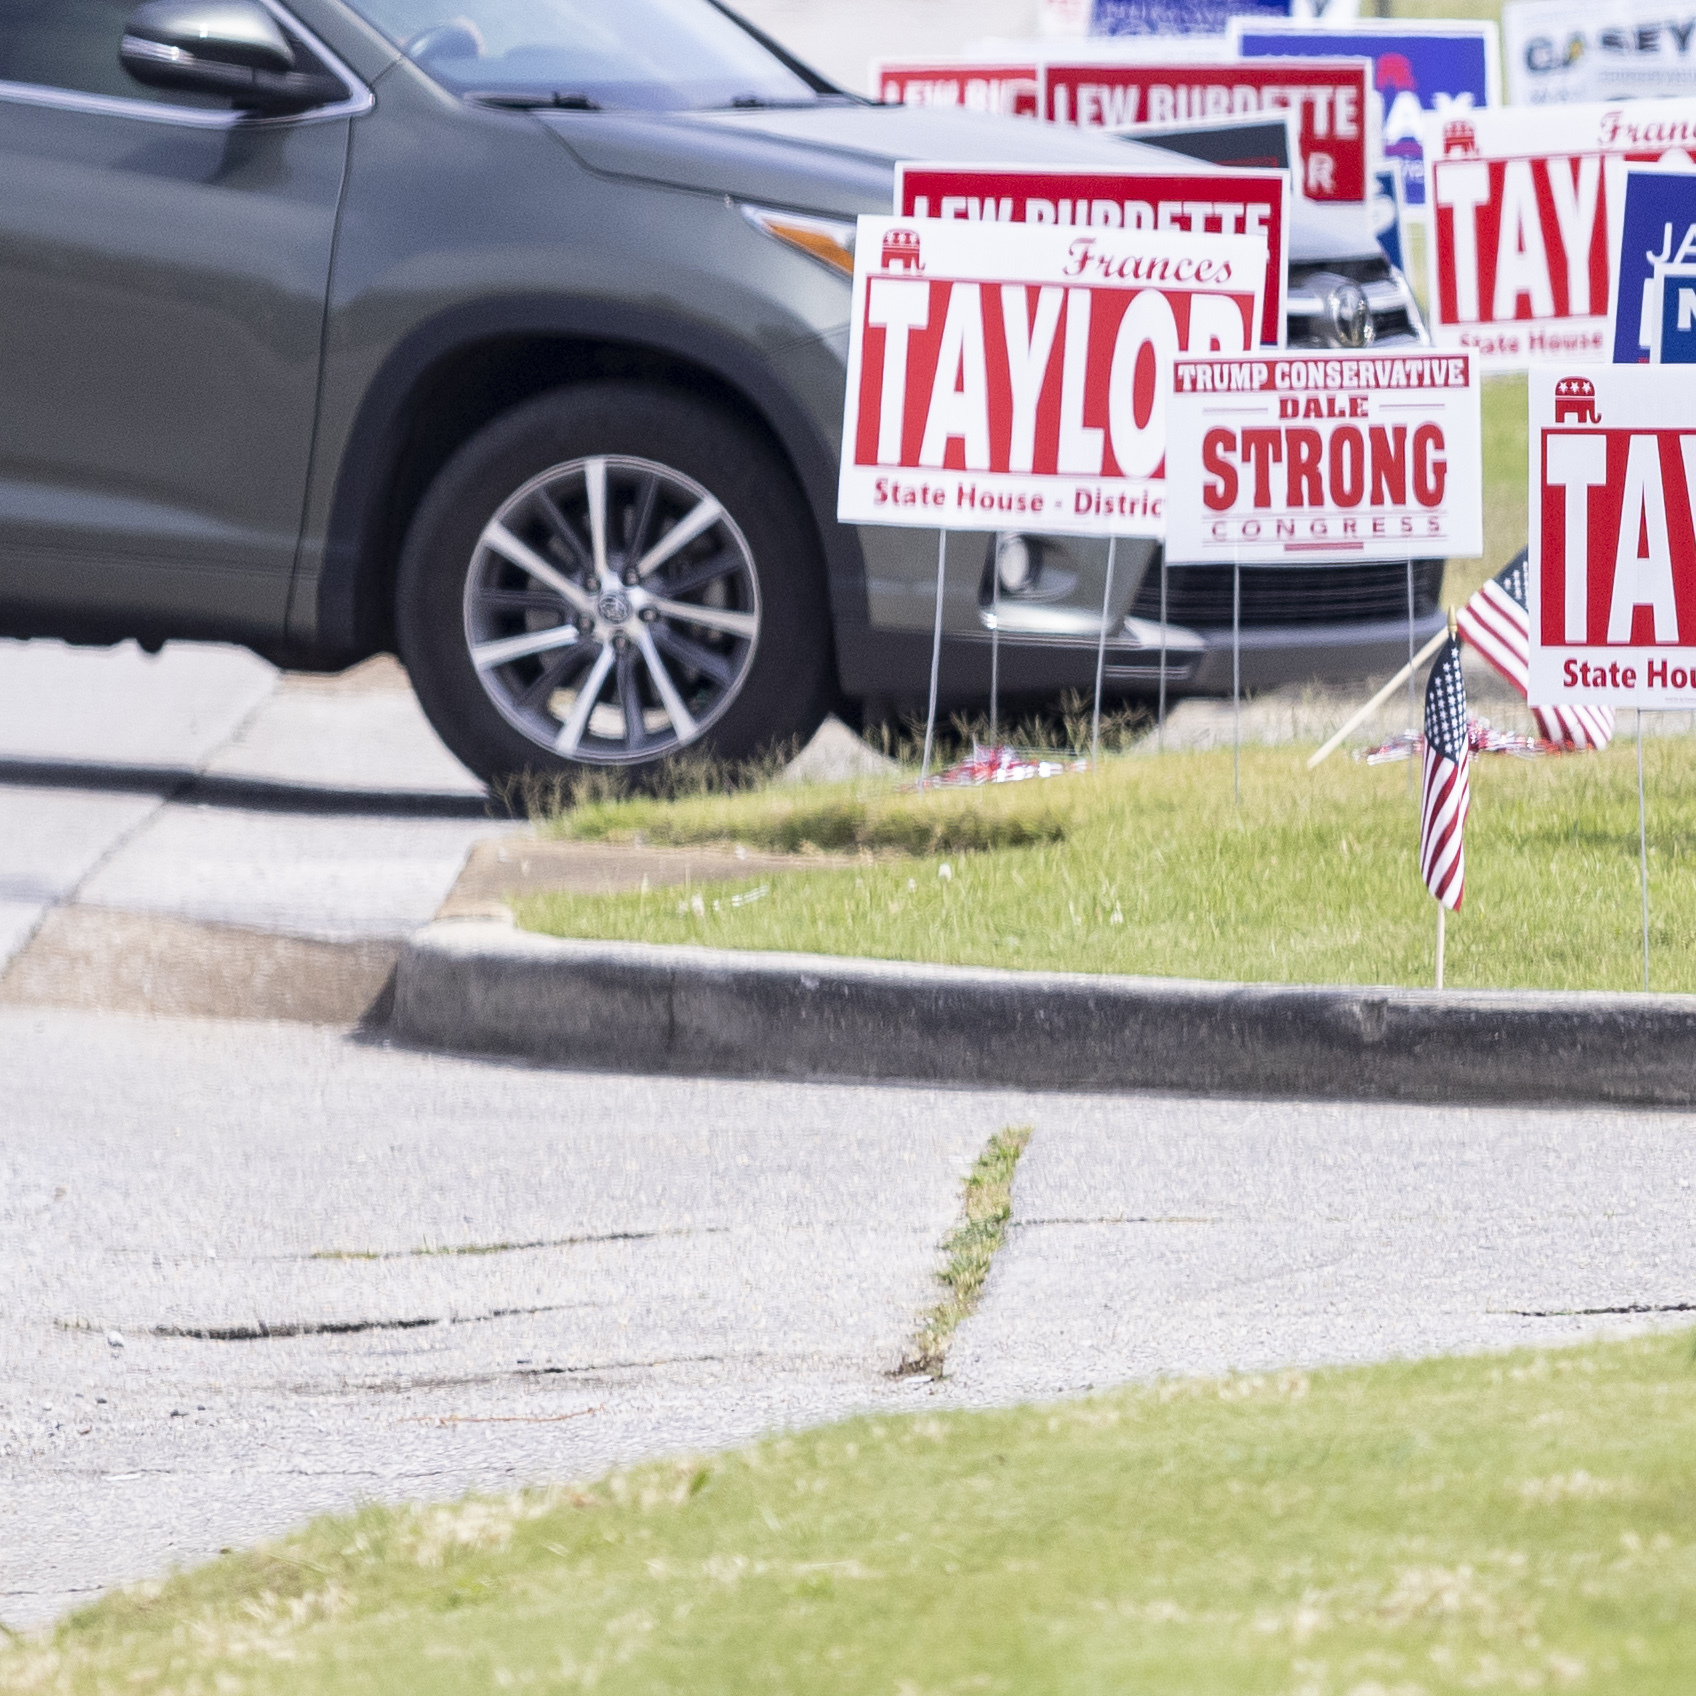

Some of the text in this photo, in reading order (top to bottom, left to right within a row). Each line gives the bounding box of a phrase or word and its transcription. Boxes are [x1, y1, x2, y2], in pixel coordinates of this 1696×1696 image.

[1062, 237, 1232, 284] Frances
[1460, 327, 1603, 355] State House
[1177, 358, 1464, 391] TRUMP CONSERVATIVE
[1278, 395, 1369, 419] DALE
[1202, 422, 1447, 511] STRONG
[875, 477, 947, 508] State
[956, 483, 1045, 514] House
[1211, 515, 1441, 542] CONGRESS
[1562, 659, 1637, 690] State
